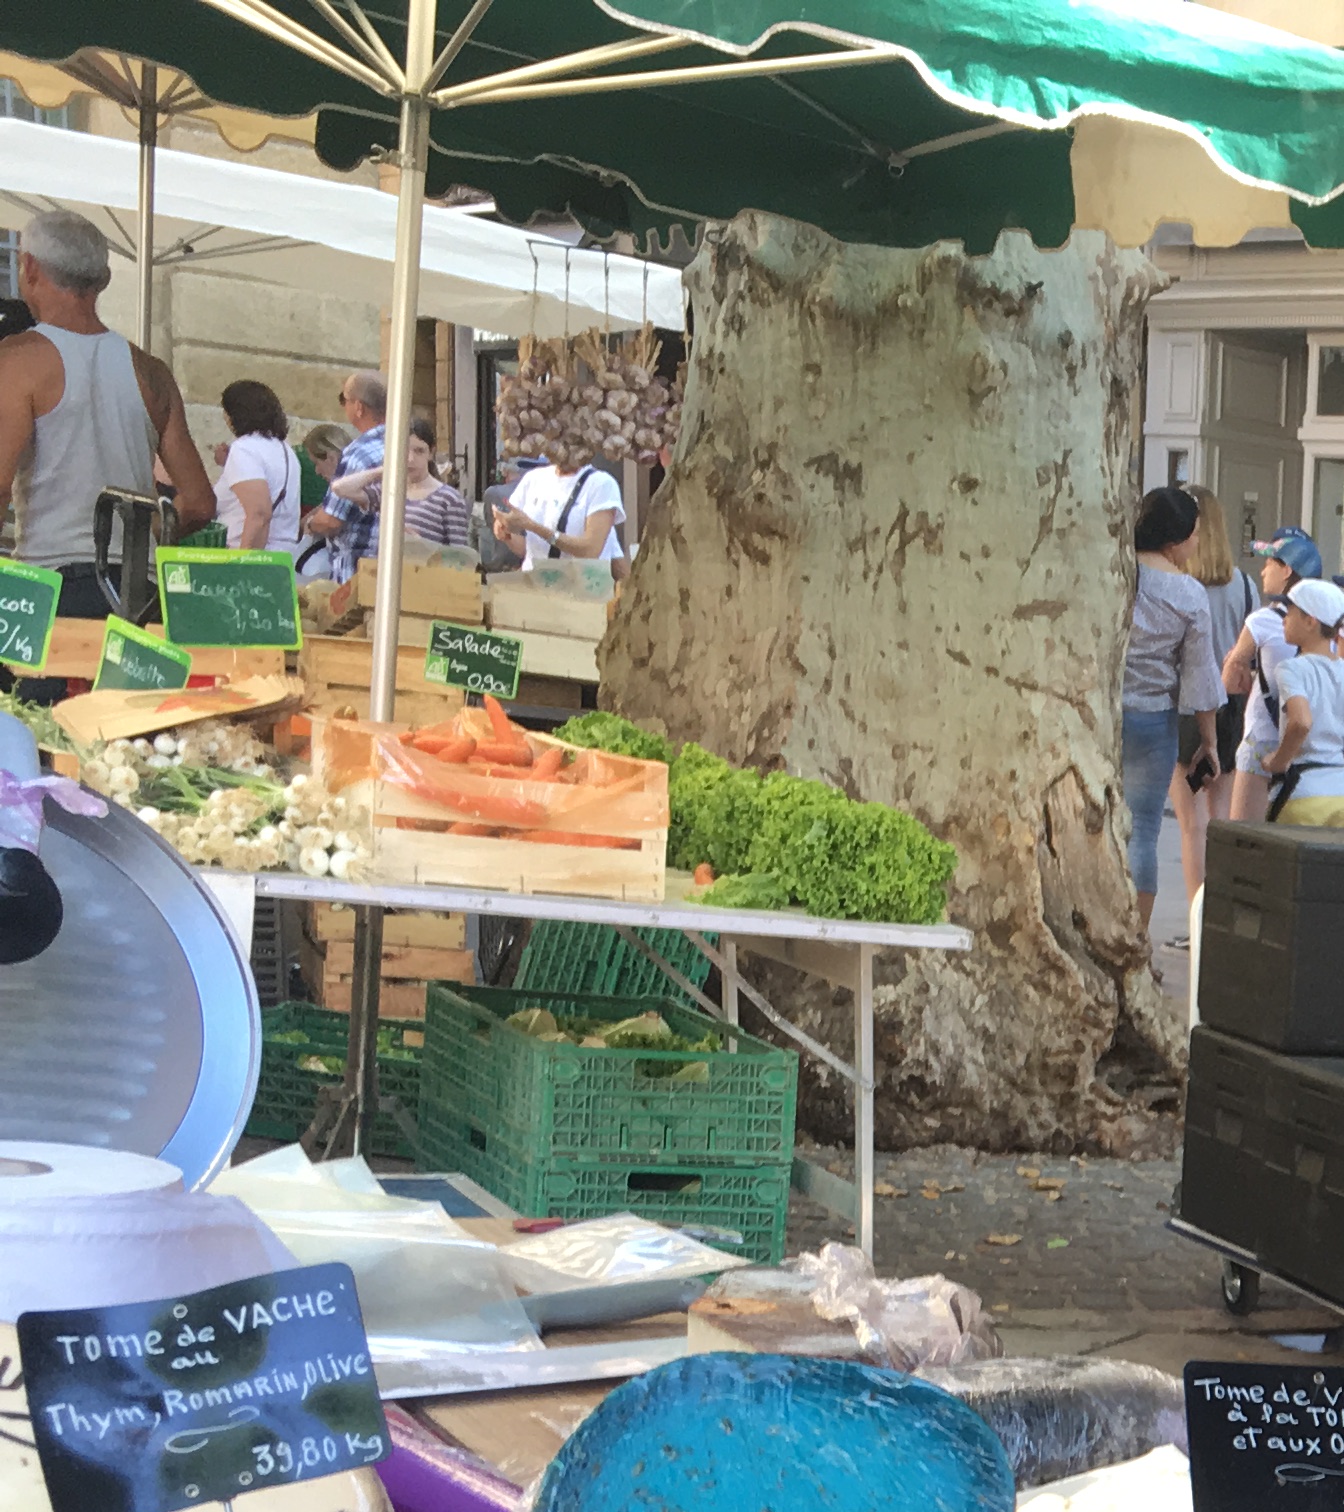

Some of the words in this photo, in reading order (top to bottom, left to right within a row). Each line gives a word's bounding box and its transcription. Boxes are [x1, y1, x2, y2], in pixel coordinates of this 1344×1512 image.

[434, 631, 504, 658] Salade
[177, 1324, 216, 1348] de
[171, 1350, 220, 1371] au
[1194, 1377, 1265, 1404] Tome
[1273, 1382, 1311, 1406] de
[1227, 1403, 1248, 1424] à
[1261, 1404, 1298, 1426] la
[252, 1436, 338, 1479] 39,80
[1267, 1438, 1321, 1456] aux
